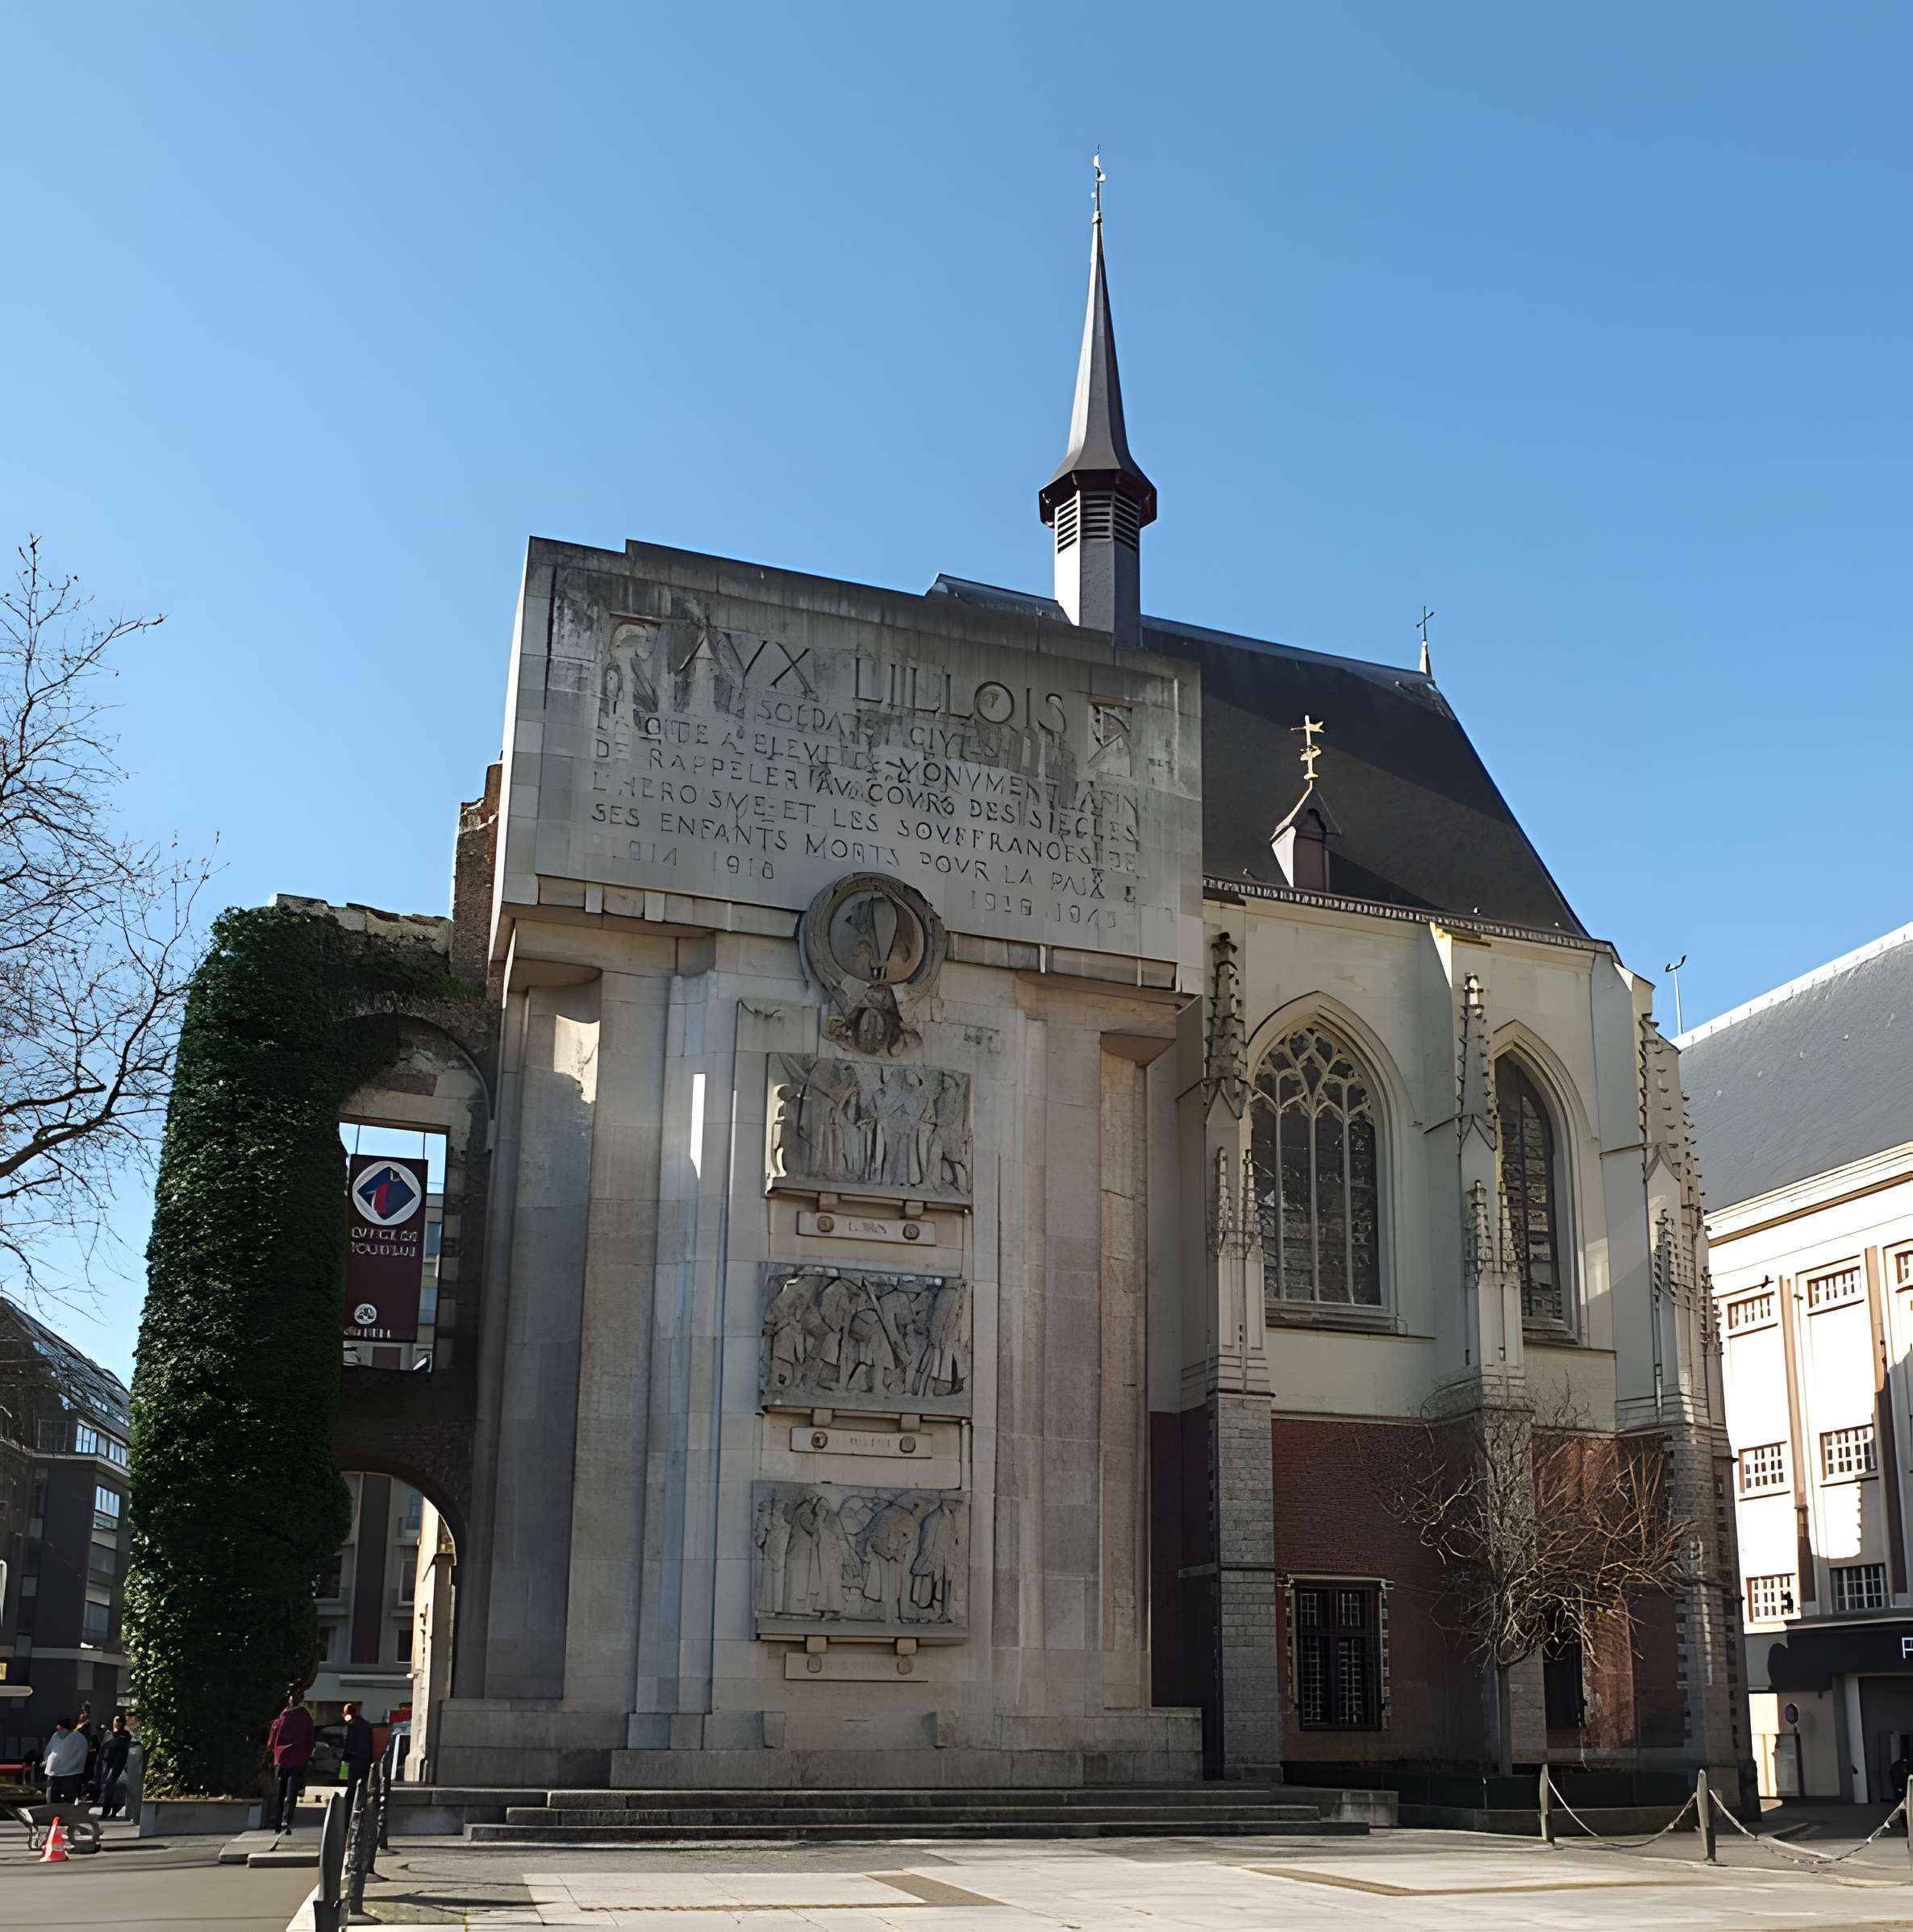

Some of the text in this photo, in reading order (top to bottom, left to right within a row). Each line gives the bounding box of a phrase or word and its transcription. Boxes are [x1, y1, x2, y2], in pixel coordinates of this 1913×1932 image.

[649, 747, 798, 790] RAPPELER
[969, 798, 1015, 824] DES
[783, 800, 817, 824] ET
[834, 809, 879, 832] LES
[591, 803, 640, 827] SES
[661, 812, 788, 851] ENFANTS
[1005, 864, 1033, 885] LA
